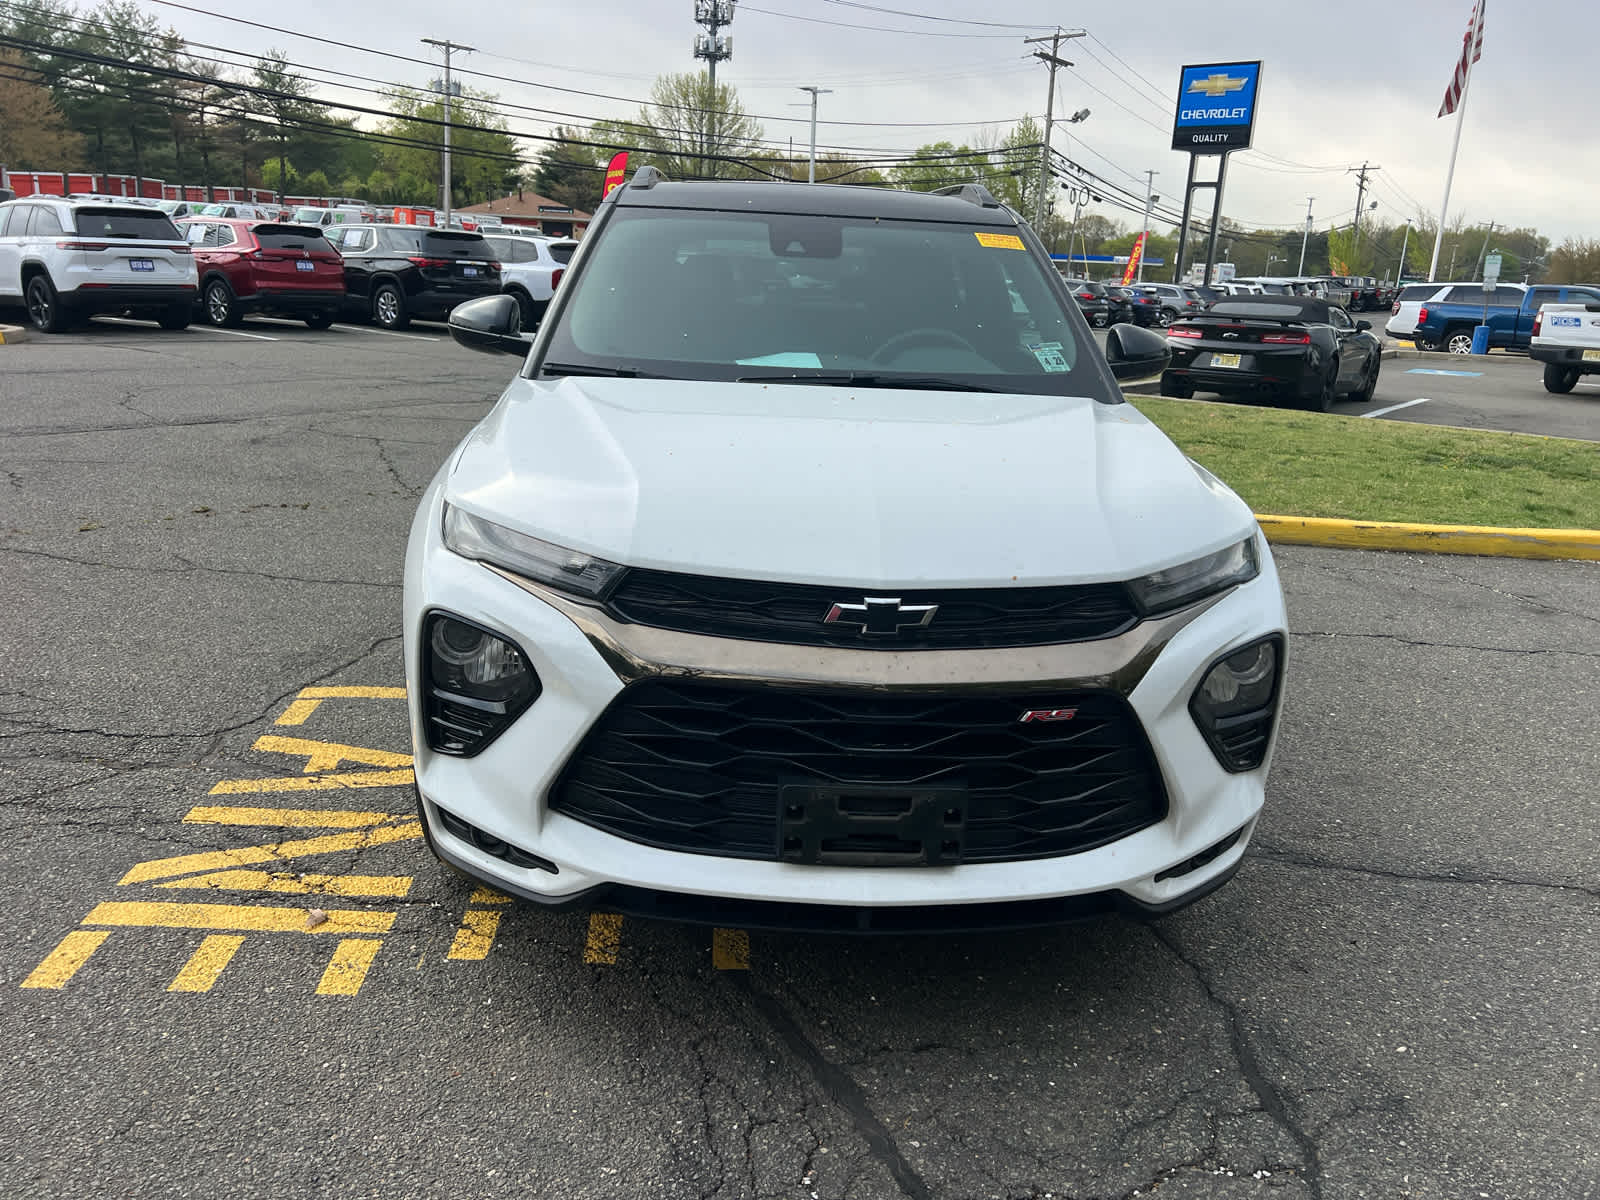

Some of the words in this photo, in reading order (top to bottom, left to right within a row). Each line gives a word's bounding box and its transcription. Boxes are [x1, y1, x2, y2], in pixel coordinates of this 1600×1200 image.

[1181, 107, 1247, 120] CHEVROLET
[1192, 134, 1229, 143] QUALITY
[1019, 708, 1079, 723] RS
